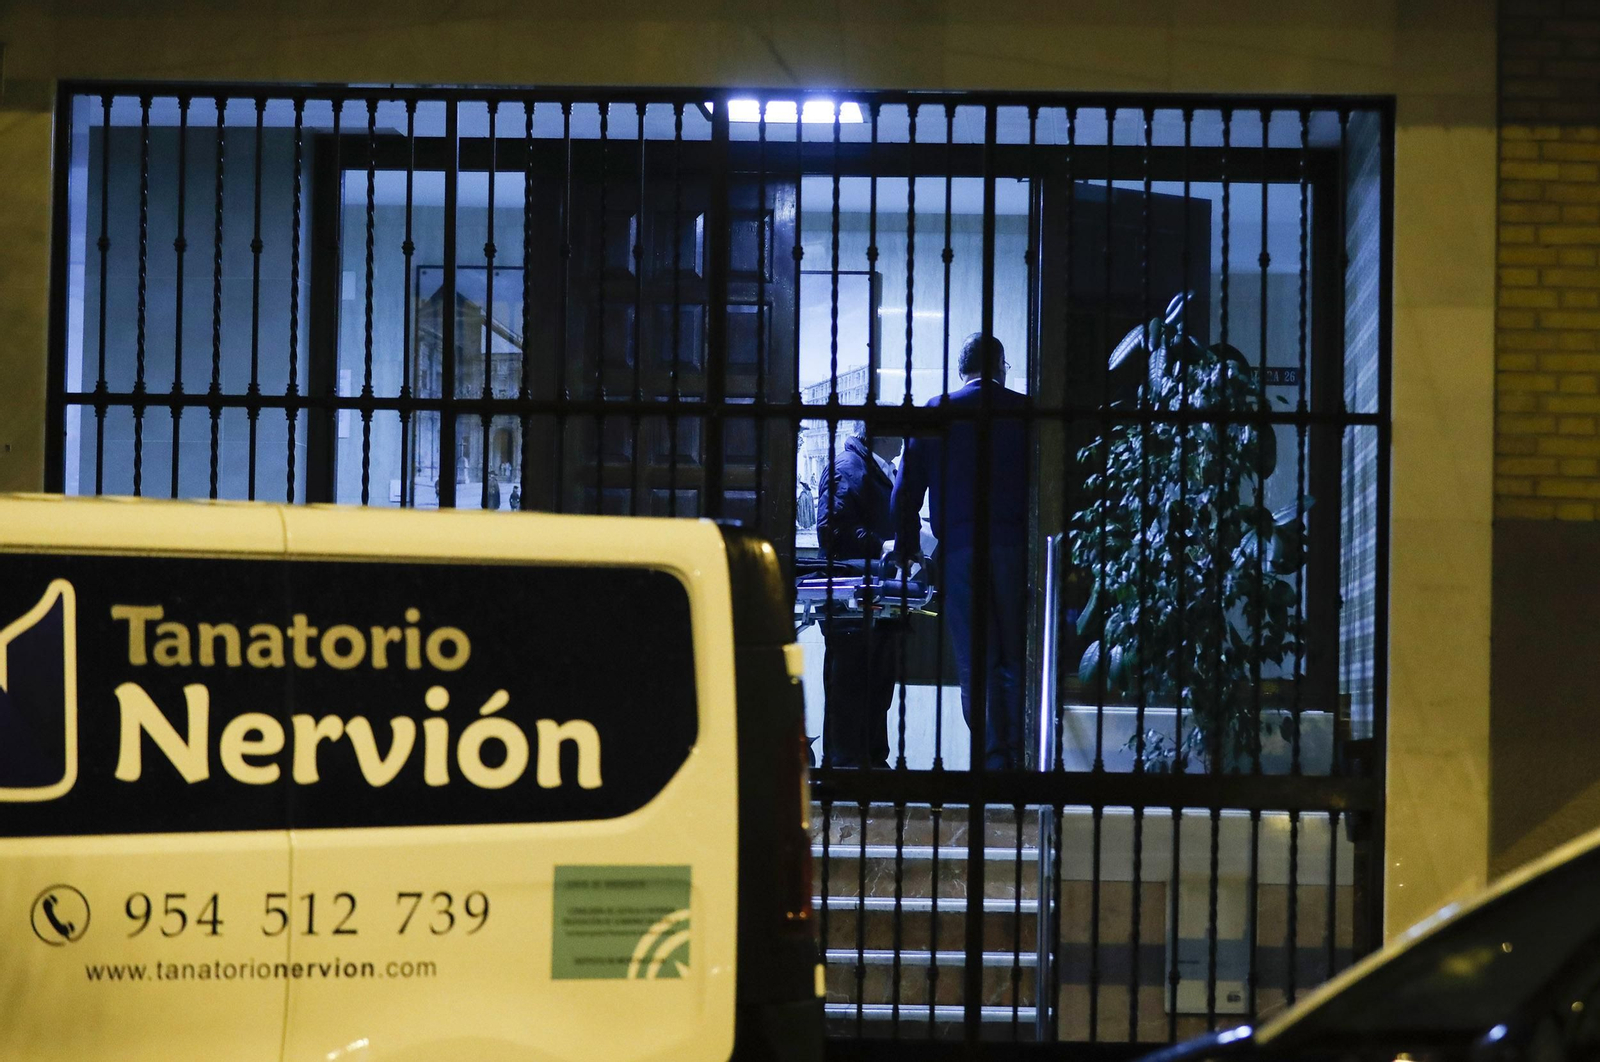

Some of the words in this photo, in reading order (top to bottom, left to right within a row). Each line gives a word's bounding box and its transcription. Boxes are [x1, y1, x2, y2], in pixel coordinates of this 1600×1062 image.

[1284, 370, 1296, 383] 26
[111, 605, 472, 671] Tanatorio
[113, 682, 604, 790] Nervión
[125, 892, 225, 938] 954
[261, 891, 358, 937] 512
[396, 890, 492, 936] 739
[85, 957, 437, 982] www.tanatorionervion.com
